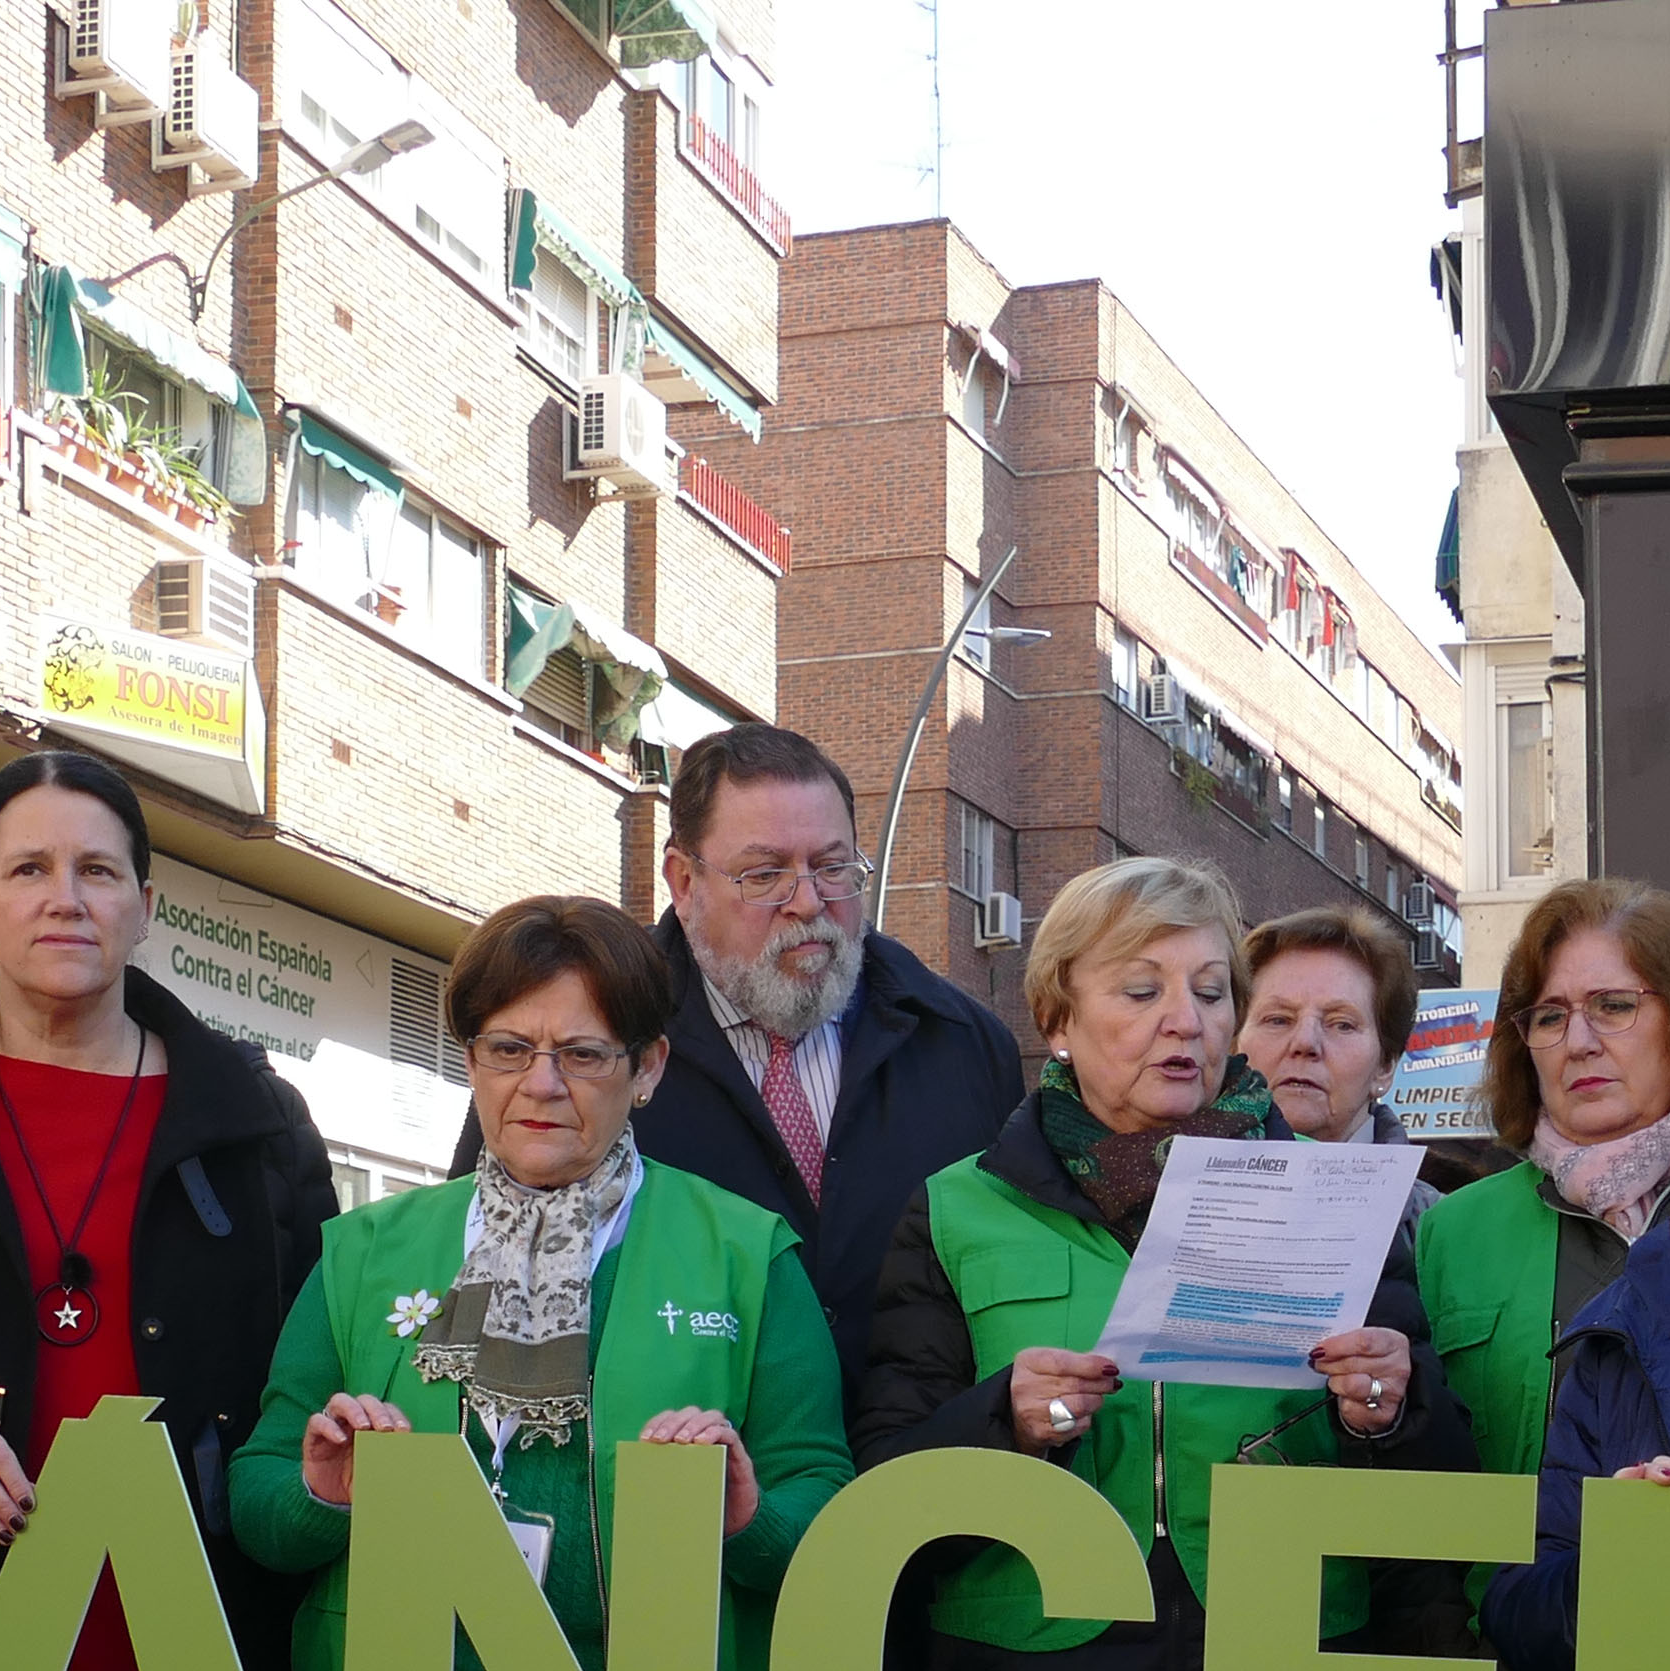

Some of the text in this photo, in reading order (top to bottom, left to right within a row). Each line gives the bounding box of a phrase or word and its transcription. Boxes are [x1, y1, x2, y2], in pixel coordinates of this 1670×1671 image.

[111, 640, 153, 663] SALON
[168, 654, 241, 685] PELUQUERIA
[115, 663, 230, 725] FONSI
[108, 705, 243, 748] Asesora de Imagen
[154, 893, 332, 983] Asociación Española
[171, 943, 316, 1019] Contra el Cáncer
[286, 1032, 297, 1058] el
[1403, 1047, 1487, 1073] LAVANDERÍA
[1399, 1113, 1427, 1128] EN
[1247, 1154, 1288, 1172] CÁNCER
